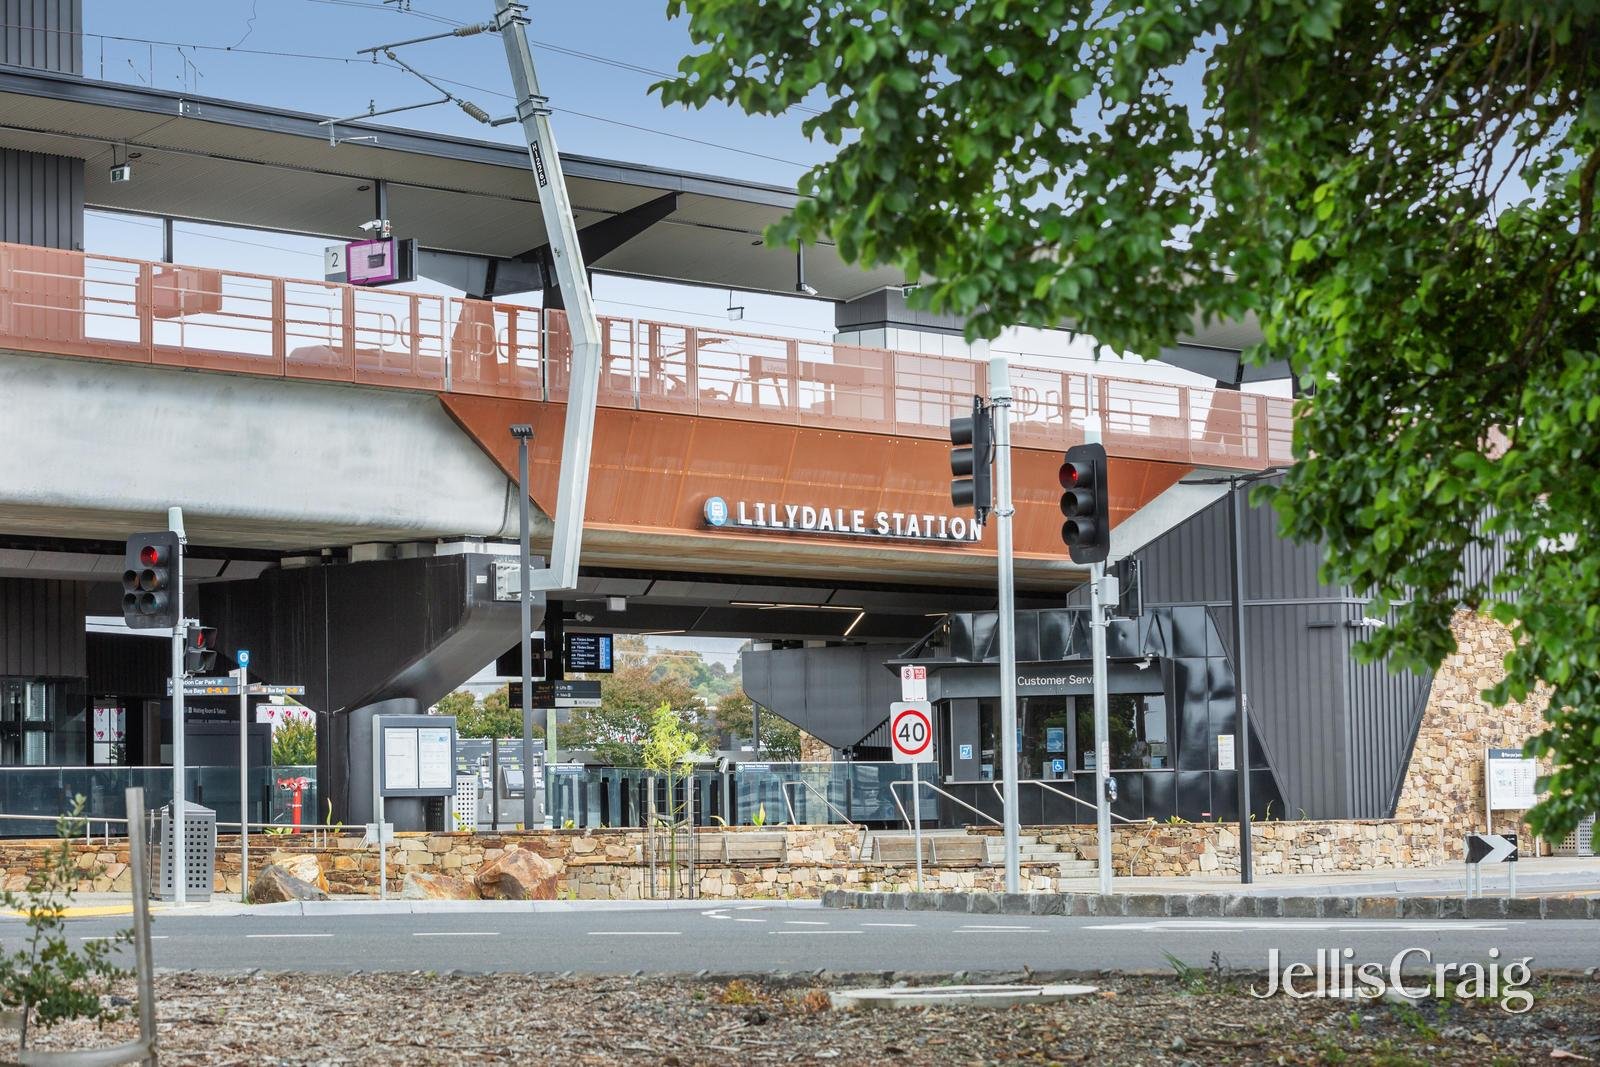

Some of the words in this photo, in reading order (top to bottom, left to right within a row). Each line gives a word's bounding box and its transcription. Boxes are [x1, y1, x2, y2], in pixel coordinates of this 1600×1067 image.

[331, 252, 339, 267] 2
[736, 501, 866, 533] LILYDALE
[876, 511, 982, 541] STATION
[1017, 676, 1066, 686] Customer
[1069, 674, 1095, 685] Servi
[899, 723, 925, 742] 40
